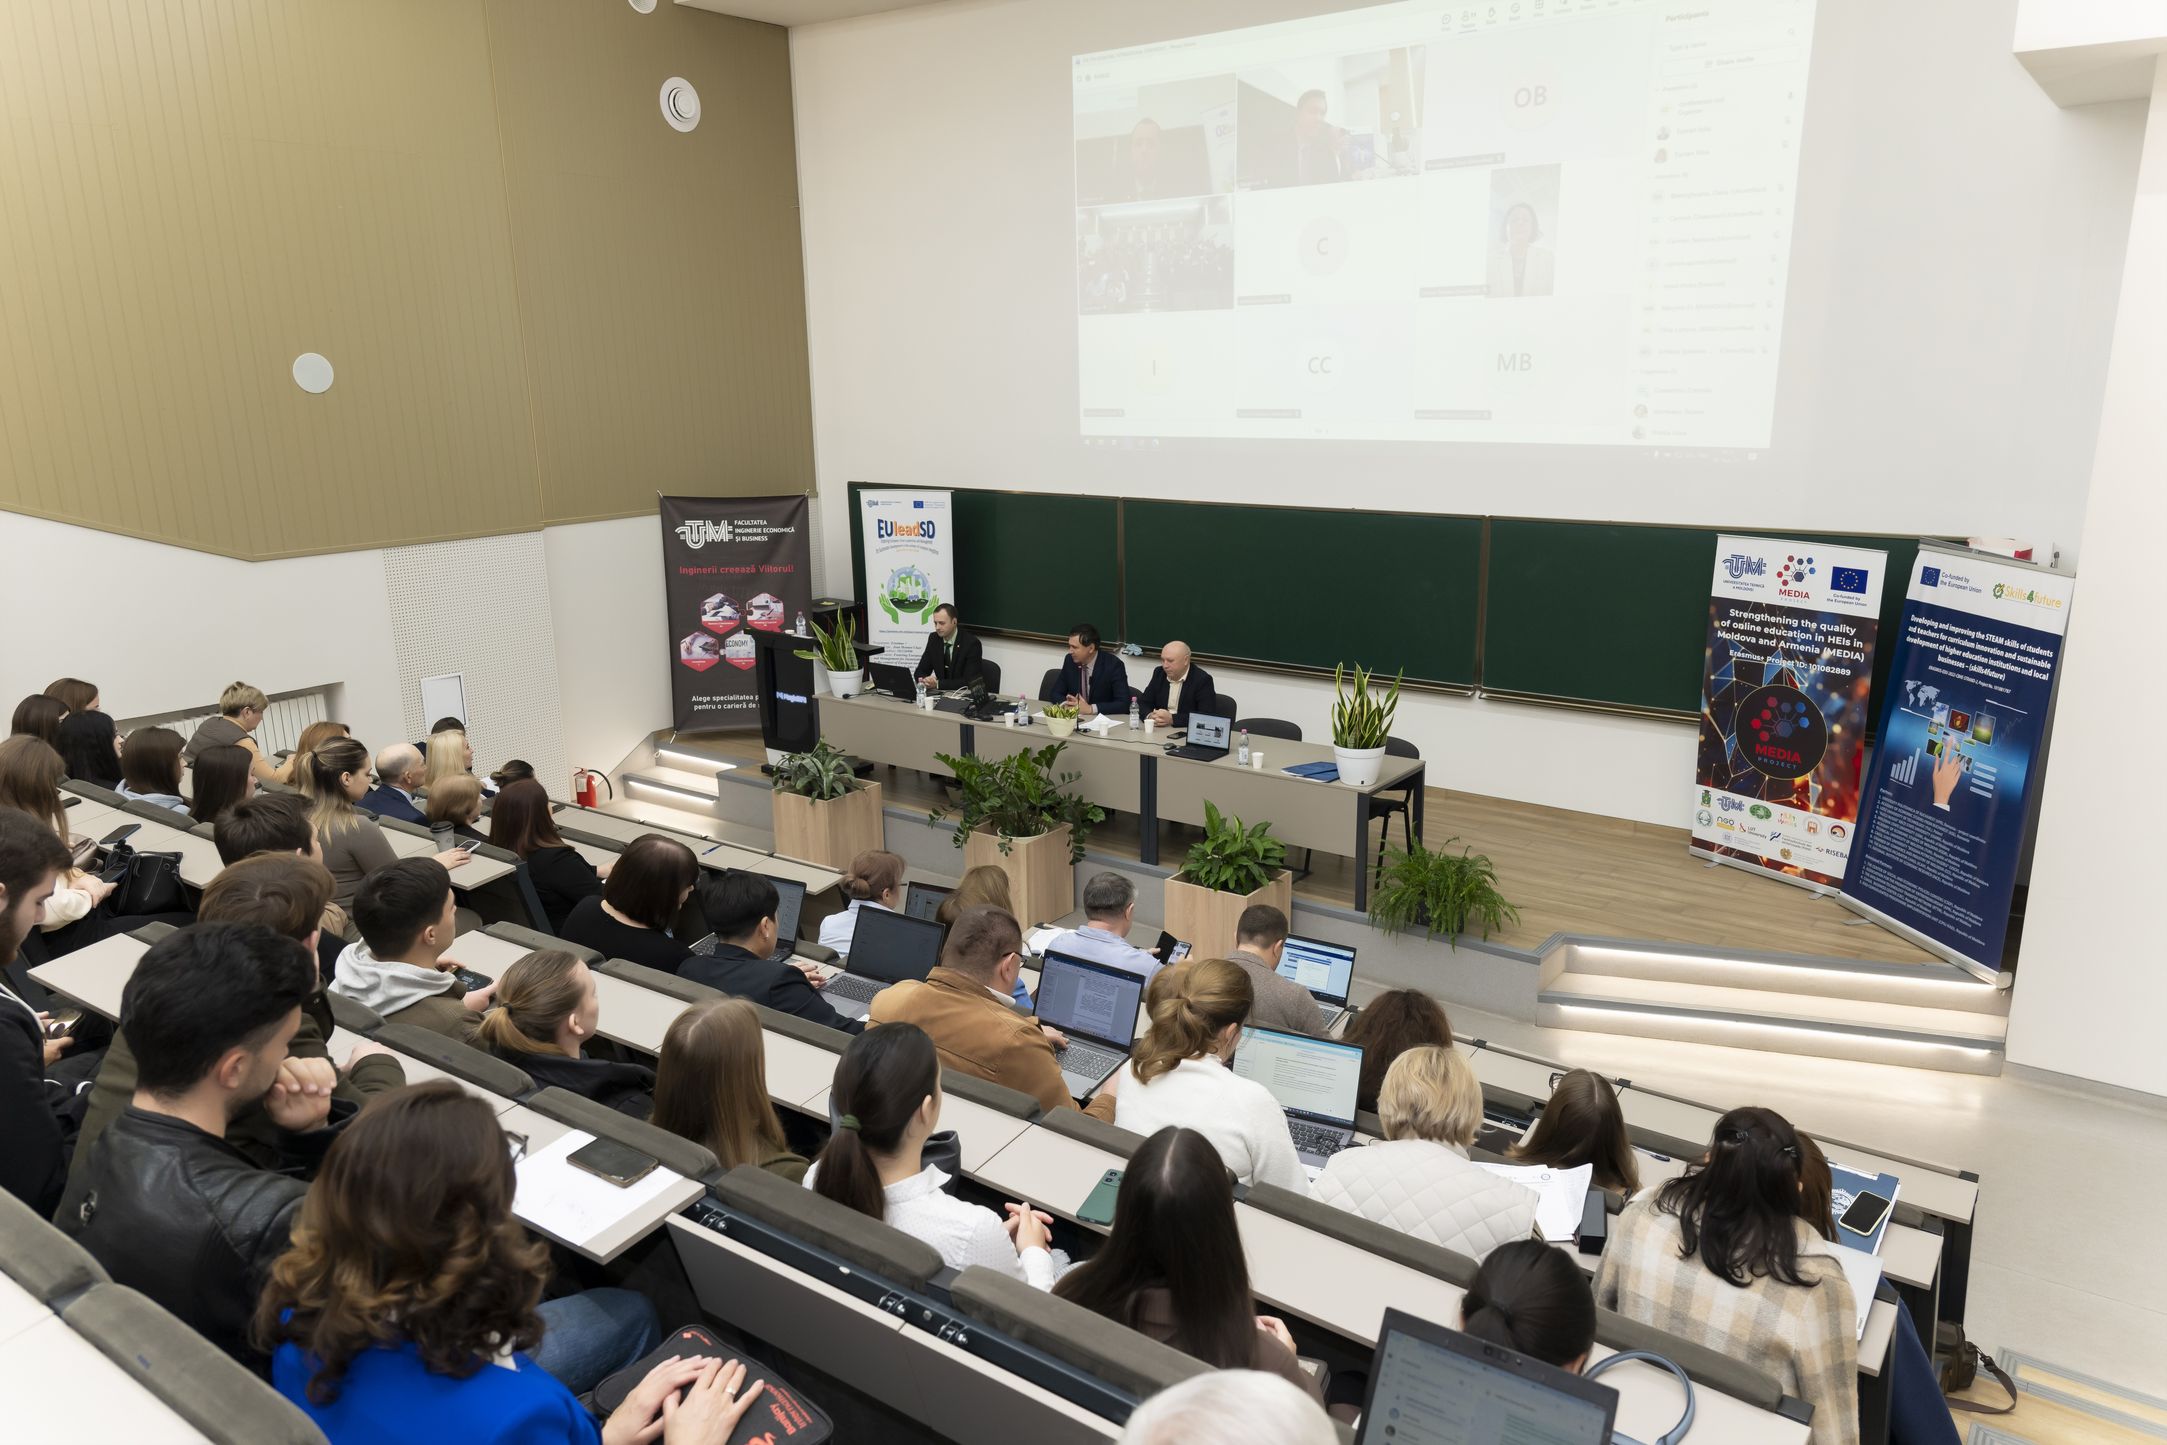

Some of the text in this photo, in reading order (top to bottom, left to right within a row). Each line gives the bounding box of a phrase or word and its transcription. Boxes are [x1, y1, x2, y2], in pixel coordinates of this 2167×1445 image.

[1514, 85, 1547, 109] OB
[1316, 237, 1329, 256] C
[1307, 356, 1332, 374] CC
[1496, 353, 1533, 372] MB
[680, 563, 794, 576] Inginerii creează Viitorul!
[1941, 572, 1965, 582] Co-funded
[1778, 588, 1810, 599] MEDIA
[1947, 581, 1968, 592] European
[1969, 586, 1982, 594] Union
[2005, 586, 2062, 608] Skills4future
[1729, 608, 1856, 636] Strengthening the quality
[1732, 622, 1761, 632] online
[1763, 627, 1812, 640] education
[1815, 633, 1824, 642] in
[1827, 635, 1851, 646] HEIs
[1853, 638, 1863, 648] in
[1911, 614, 1938, 629] Developing
[1939, 622, 1949, 630] and
[1949, 624, 1975, 638] improving
[1975, 631, 1985, 640] the
[1985, 633, 2004, 645] STEAM
[2004, 638, 2019, 649] skills
[2027, 645, 2053, 658] students
[1717, 630, 1865, 663] Moldova and Armenia (MEDIA)
[1917, 627, 1939, 638] teachers
[1939, 632, 1947, 641] for
[1947, 636, 1975, 648] curriculum
[1975, 642, 2004, 657] innovation
[2004, 651, 2017, 660] and
[2017, 654, 2051, 669] sustainable
[1729, 650, 1851, 676] Erasmus+ Project ID: 101082889
[1906, 634, 1938, 649] development
[1945, 644, 1962, 656] higher
[1962, 651, 1988, 664] education
[1988, 657, 2021, 673] institutions
[2021, 668, 2033, 677] and
[2033, 670, 2049, 681] local
[1938, 653, 1964, 668] businesses
[1968, 663, 2006, 681] (skills4future)
[694, 703, 716, 711] pentru
[712, 694, 754, 702] specialitatea
[1755, 743, 1801, 764] MEDIA
[1758, 756, 1796, 769] PROJECT
[1826, 848, 1848, 859] RISEBA
